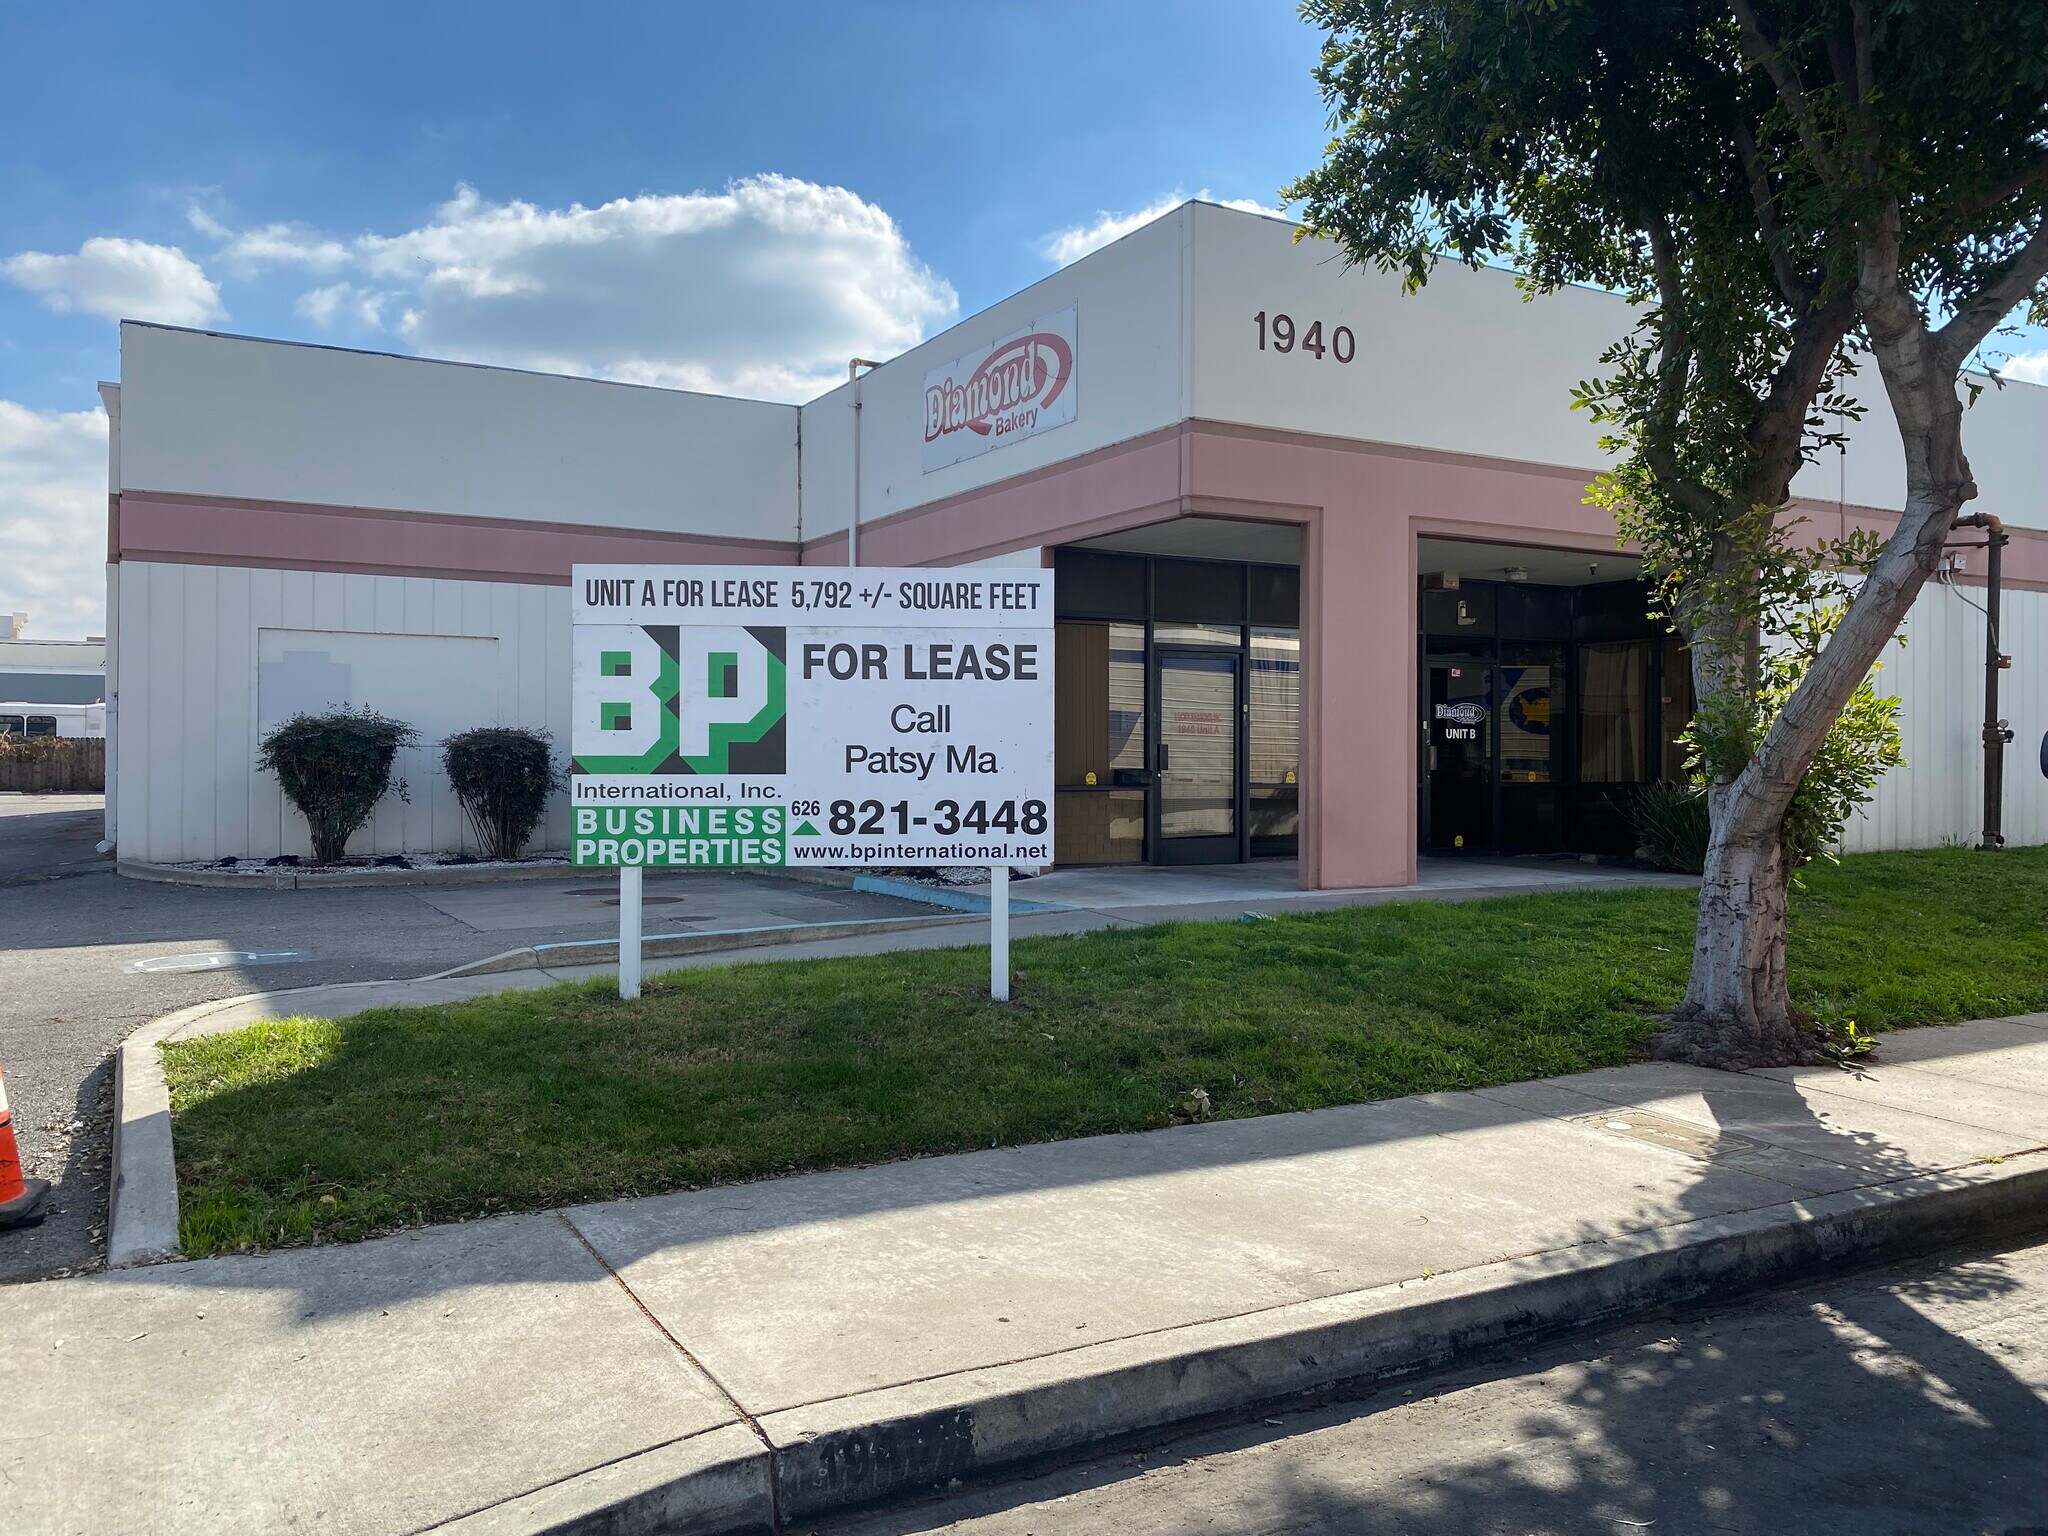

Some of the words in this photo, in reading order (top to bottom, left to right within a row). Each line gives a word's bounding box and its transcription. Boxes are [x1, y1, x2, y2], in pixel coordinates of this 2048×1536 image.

[1253, 311, 1356, 364] 1940
[925, 340, 1037, 442] Diamond
[995, 408, 1038, 436] Bakery
[586, 579, 635, 607] UNIT
[641, 579, 656, 607] A
[663, 580, 704, 607] FOR
[711, 580, 779, 608] LEASE
[791, 581, 852, 611] 5,792
[859, 582, 892, 609] +/-
[899, 582, 983, 610] SQUARE
[989, 583, 1041, 610] FEET
[803, 643, 889, 681] FOR
[904, 644, 1038, 681] LEASE
[573, 626, 783, 771] BP
[1435, 703, 1476, 719] Diamond
[890, 703, 951, 733] Call
[1197, 725, 1212, 734] Unit
[1214, 725, 1220, 734] A
[1445, 728, 1468, 739] UNIT
[1469, 728, 1476, 739] B
[845, 745, 936, 781] Patsy
[946, 745, 998, 774] Ma
[577, 783, 731, 801] International,
[741, 783, 782, 799] Inc.
[577, 808, 782, 835] BUSINESS
[791, 800, 821, 816] 626
[828, 799, 1048, 836] 821-3448
[577, 838, 782, 865] PROPERTIES
[794, 843, 1048, 862] www.bpinternational.net
